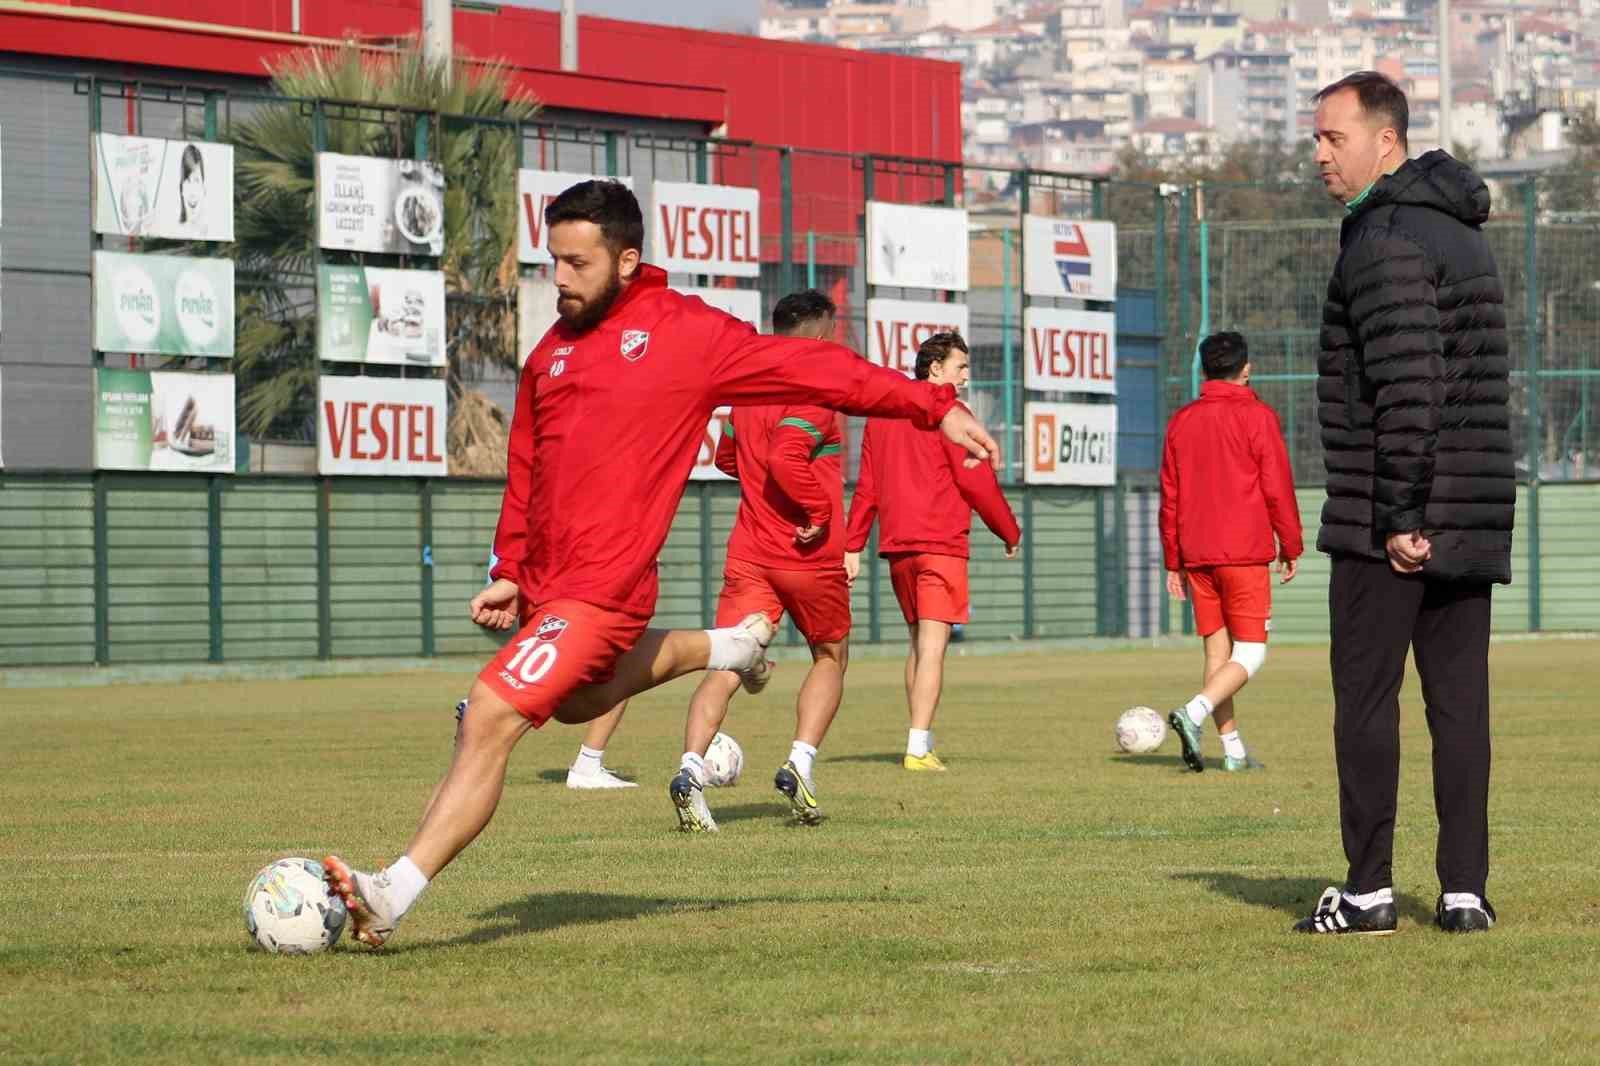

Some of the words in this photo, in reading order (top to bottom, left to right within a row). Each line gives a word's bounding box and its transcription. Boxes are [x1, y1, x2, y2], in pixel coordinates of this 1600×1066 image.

[660, 204, 759, 264] VESTEL
[1030, 327, 1113, 381] VESTEL
[324, 400, 444, 463] VESTEL
[505, 636, 557, 683] 10
